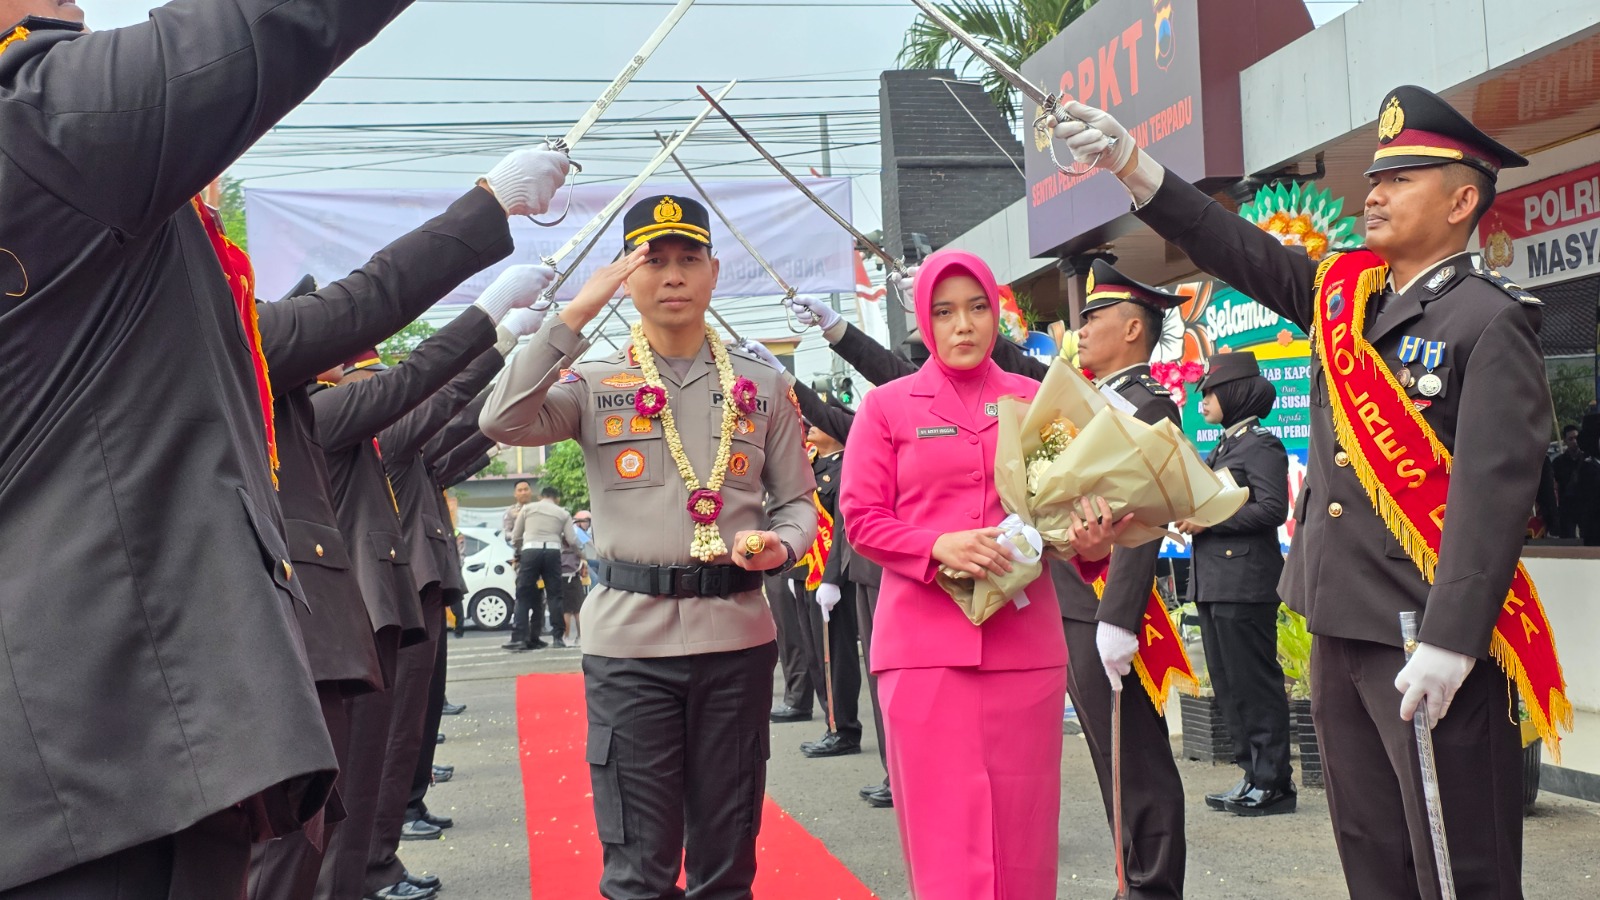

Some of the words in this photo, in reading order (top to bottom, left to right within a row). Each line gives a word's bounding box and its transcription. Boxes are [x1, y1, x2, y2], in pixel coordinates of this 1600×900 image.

[1032, 173, 1058, 207] SENTRA
[1149, 95, 1192, 143] TERPADU
[1527, 228, 1600, 278] MASY
[1197, 429, 1218, 442] AKBP
[1331, 322, 1427, 489] POLRES
